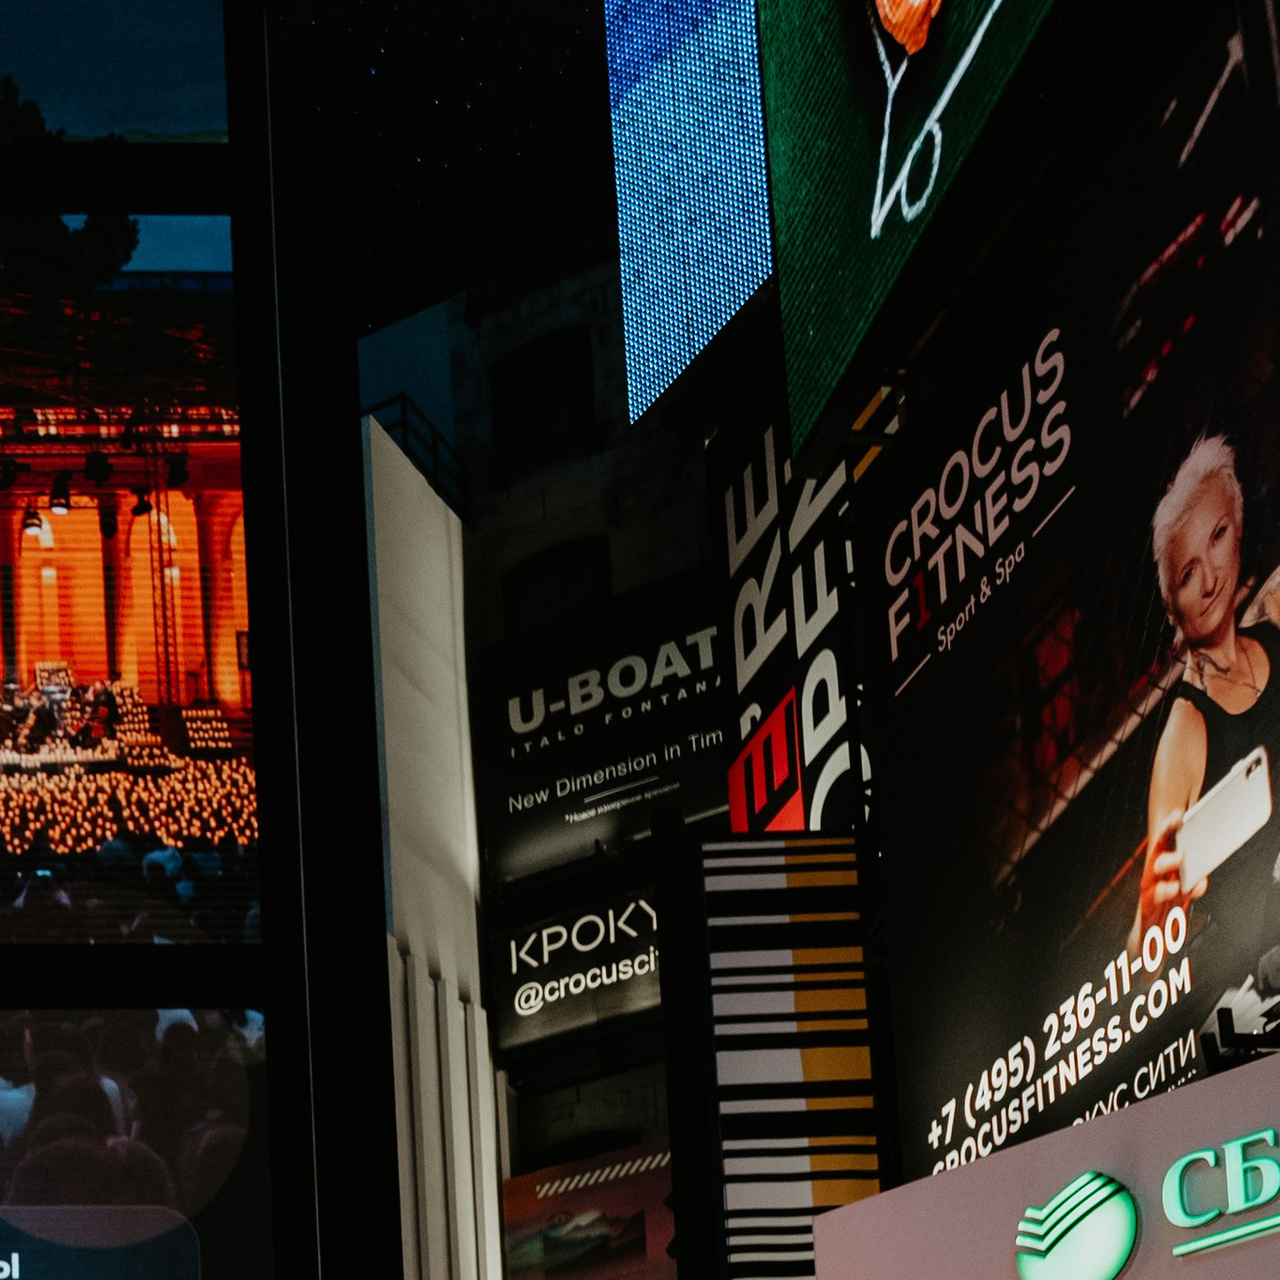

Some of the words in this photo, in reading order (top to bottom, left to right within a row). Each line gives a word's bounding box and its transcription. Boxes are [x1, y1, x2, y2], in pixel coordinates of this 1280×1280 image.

[885, 327, 1066, 588] CROCUS
[937, 593, 977, 654] Sport
[979, 576, 993, 605] &
[995, 541, 1026, 586] Spa
[507, 625, 718, 735] U-BOAT
[507, 786, 550, 814] New
[555, 748, 658, 798] Dimension
[663, 744, 682, 764] in
[509, 721, 585, 759] ITALO
[513, 944, 660, 1017] @crocusci
[927, 1096, 957, 1151] +7
[963, 1035, 1037, 1130] (495)
[1042, 905, 1188, 1062] 236-11-00
[1133, 1028, 1197, 1100] СИТИ
